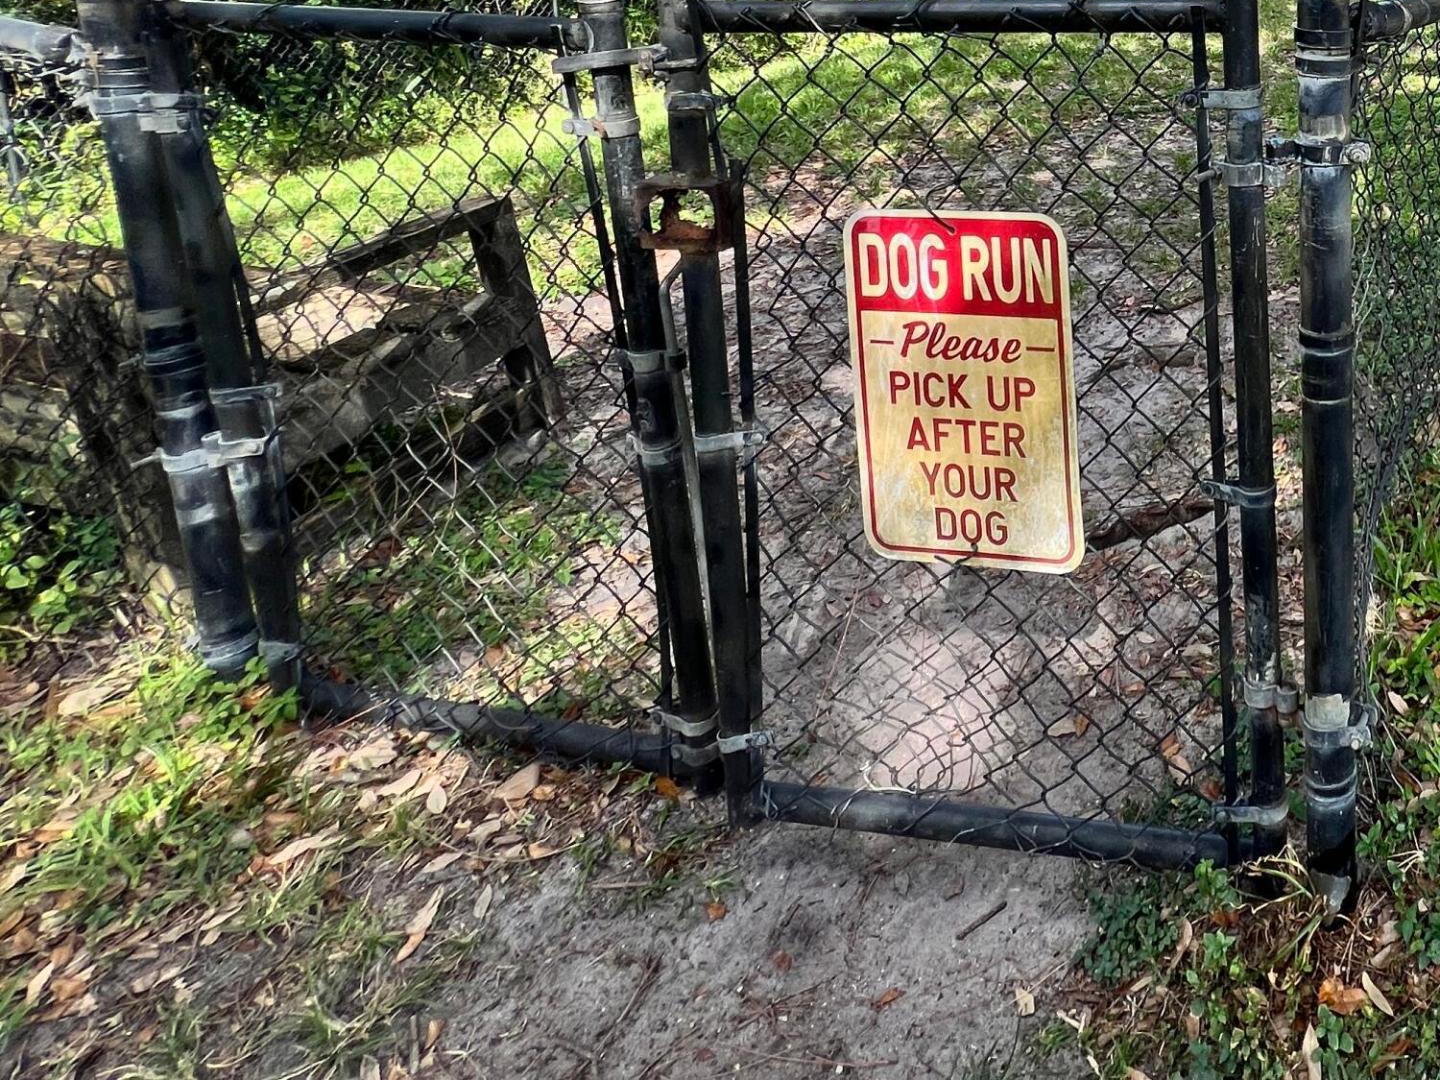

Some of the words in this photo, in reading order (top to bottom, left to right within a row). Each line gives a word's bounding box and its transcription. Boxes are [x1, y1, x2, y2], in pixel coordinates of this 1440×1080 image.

[857, 233, 948, 302] DOG
[960, 235, 1054, 304] RUN
[900, 321, 1022, 363] Please
[889, 370, 972, 409] PICK
[987, 375, 1036, 412] UP
[907, 417, 1026, 458] AFTER
[919, 461, 1018, 502] YOUR
[935, 507, 1009, 546] DOG
